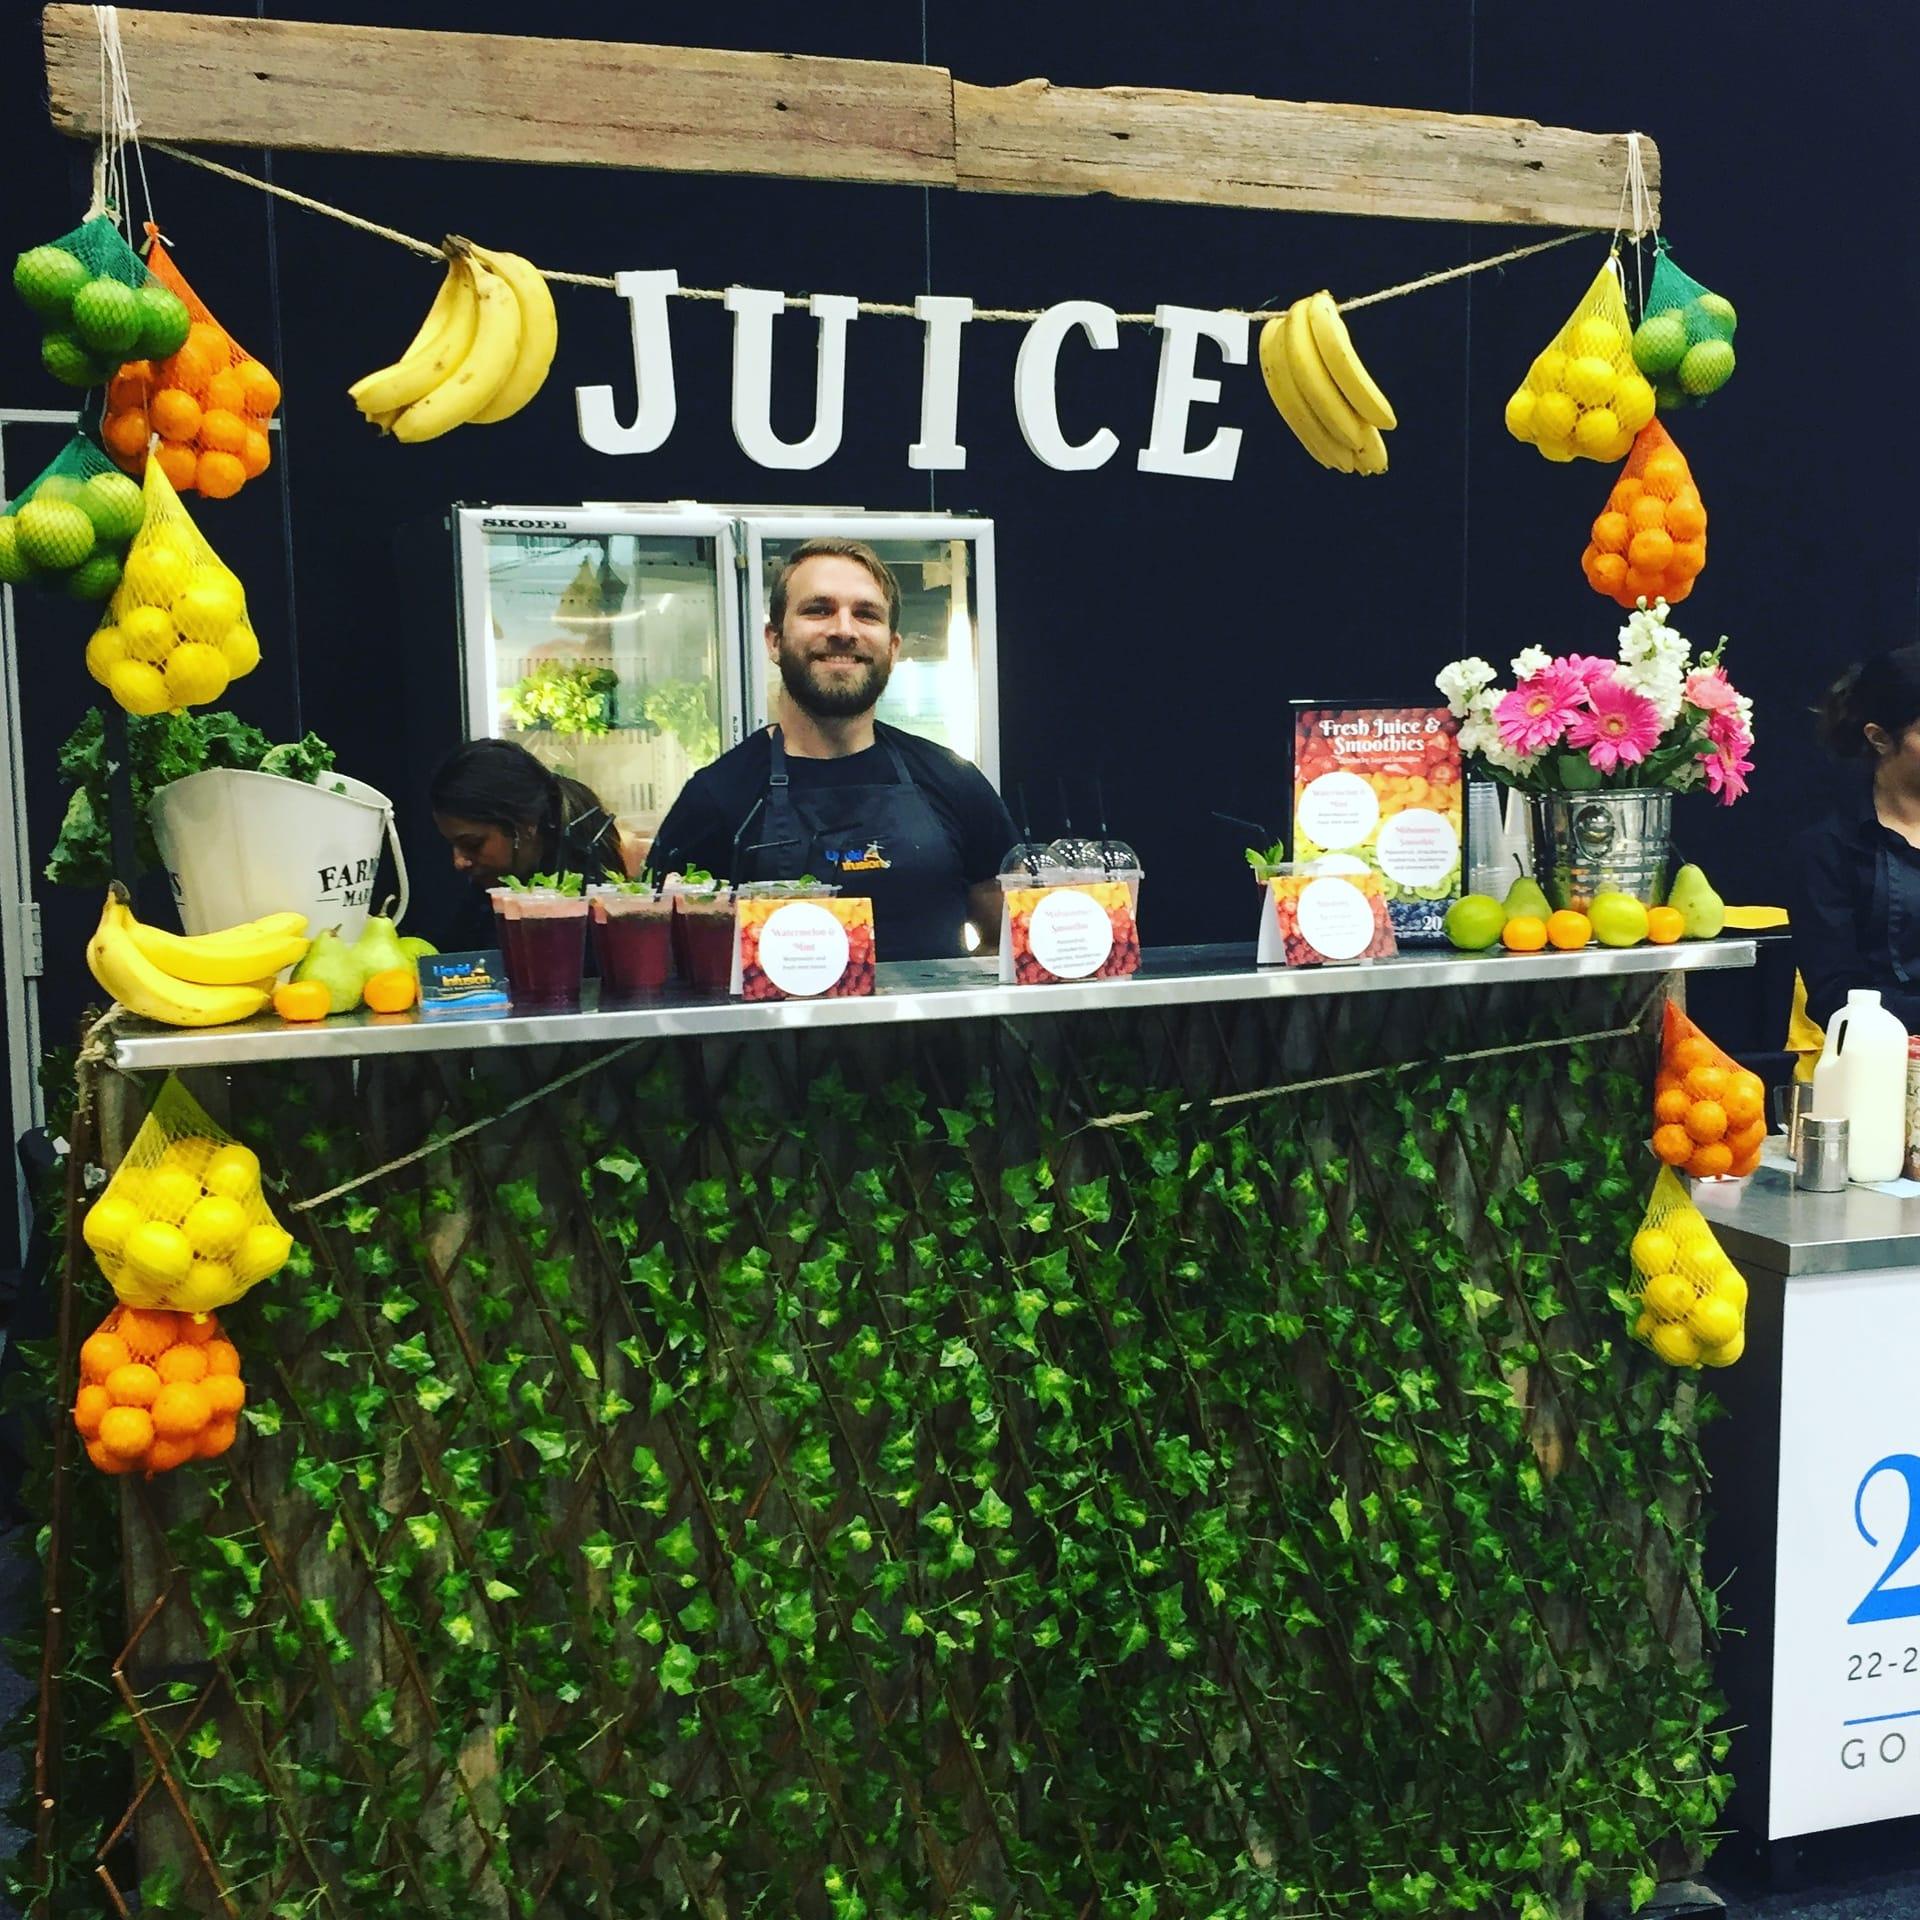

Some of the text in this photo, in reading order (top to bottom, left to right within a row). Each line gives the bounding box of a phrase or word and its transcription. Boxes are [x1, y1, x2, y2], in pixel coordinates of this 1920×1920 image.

[575, 269, 1249, 481] JUICE
[482, 518, 567, 529] SKOPE
[1319, 717, 1441, 737] Fresh Juice &
[1333, 735, 1425, 754] Smoothies
[1841, 1732, 1906, 1770] GO
